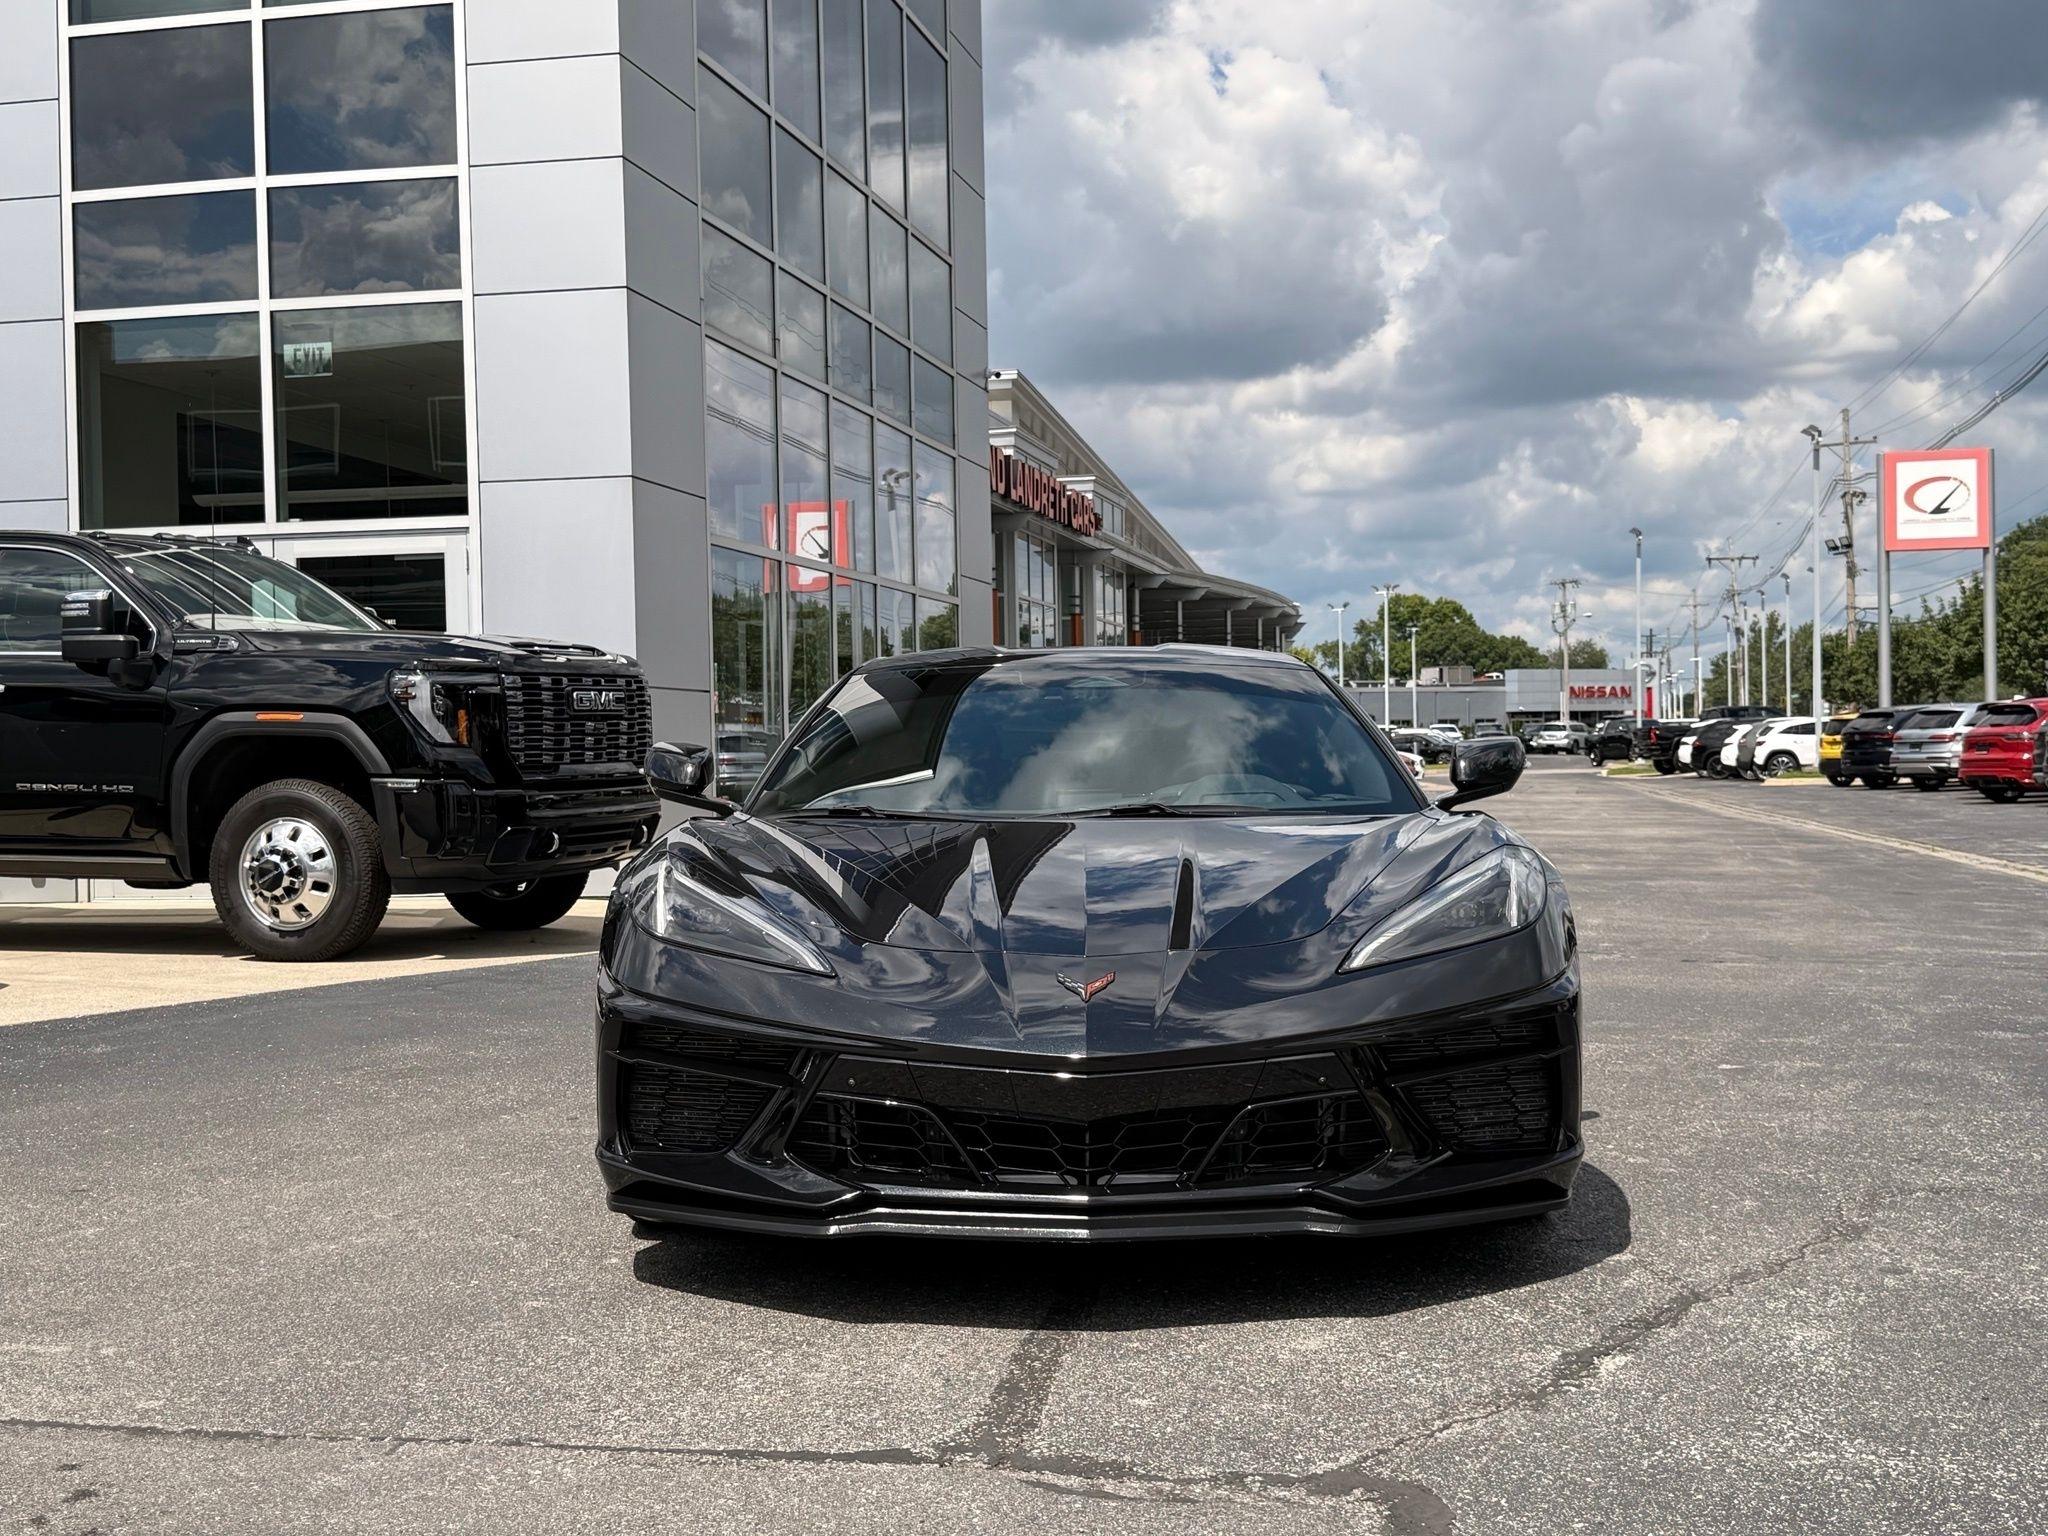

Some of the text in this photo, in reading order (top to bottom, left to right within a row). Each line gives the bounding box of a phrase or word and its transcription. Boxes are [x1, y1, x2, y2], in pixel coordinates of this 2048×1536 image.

[293, 347, 324, 371] EXIT
[1010, 459, 1067, 526] LANDRETH
[1071, 489, 1095, 537] CARS
[573, 691, 626, 710] GMC
[1569, 686, 1632, 698] NISSAN
